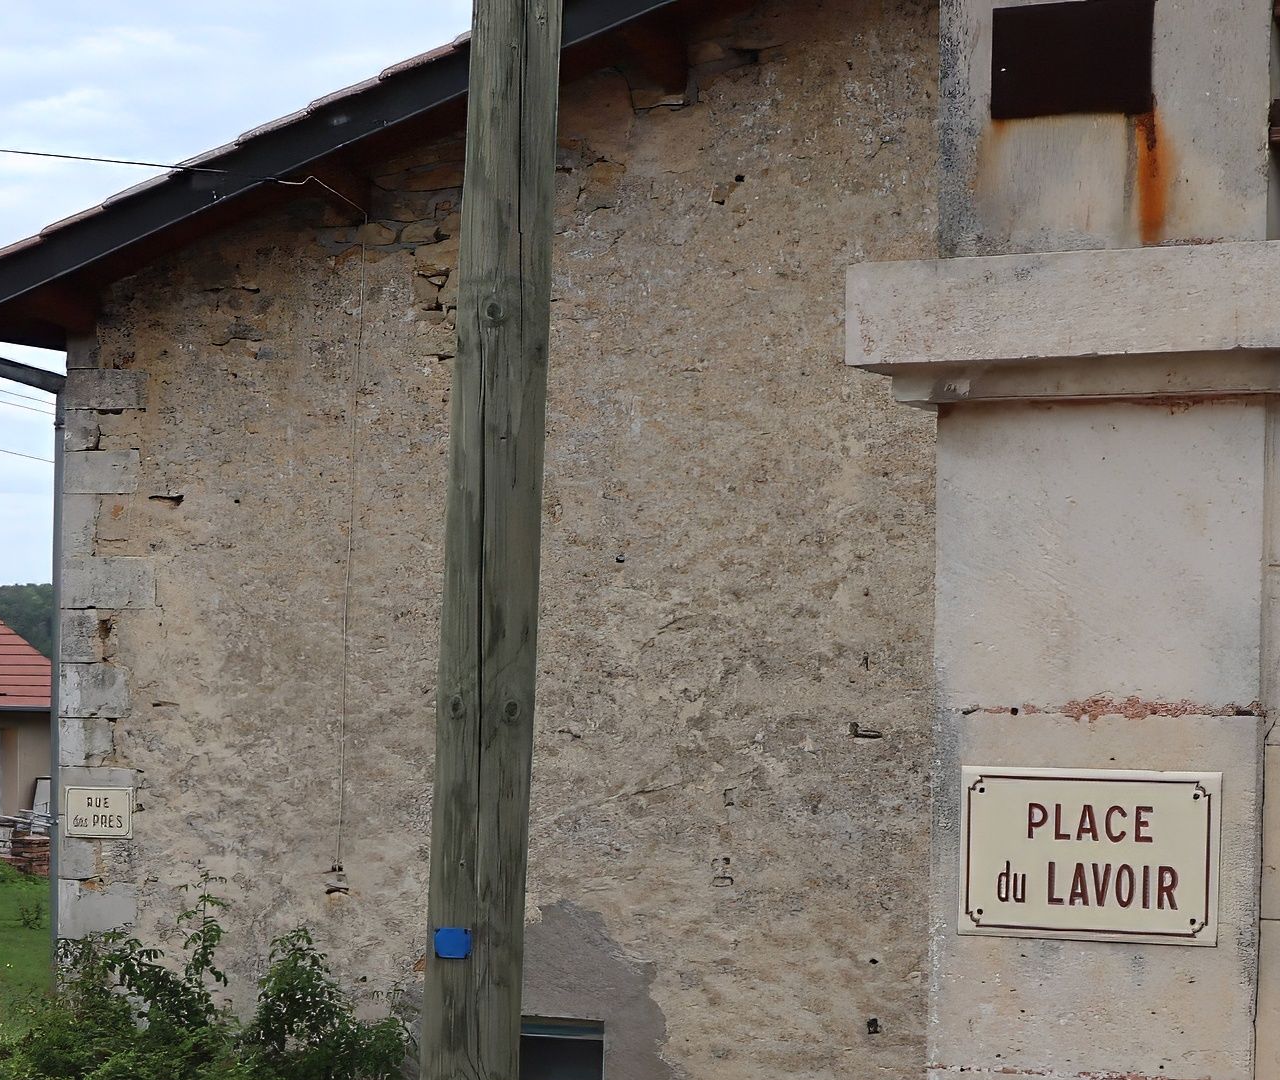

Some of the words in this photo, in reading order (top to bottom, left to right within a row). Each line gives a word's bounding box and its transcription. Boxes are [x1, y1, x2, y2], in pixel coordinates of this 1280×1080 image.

[87, 797, 110, 808] RUE
[1027, 802, 1154, 844] PLACE
[997, 860, 1026, 903] du
[1047, 861, 1179, 911] LAVOIR
